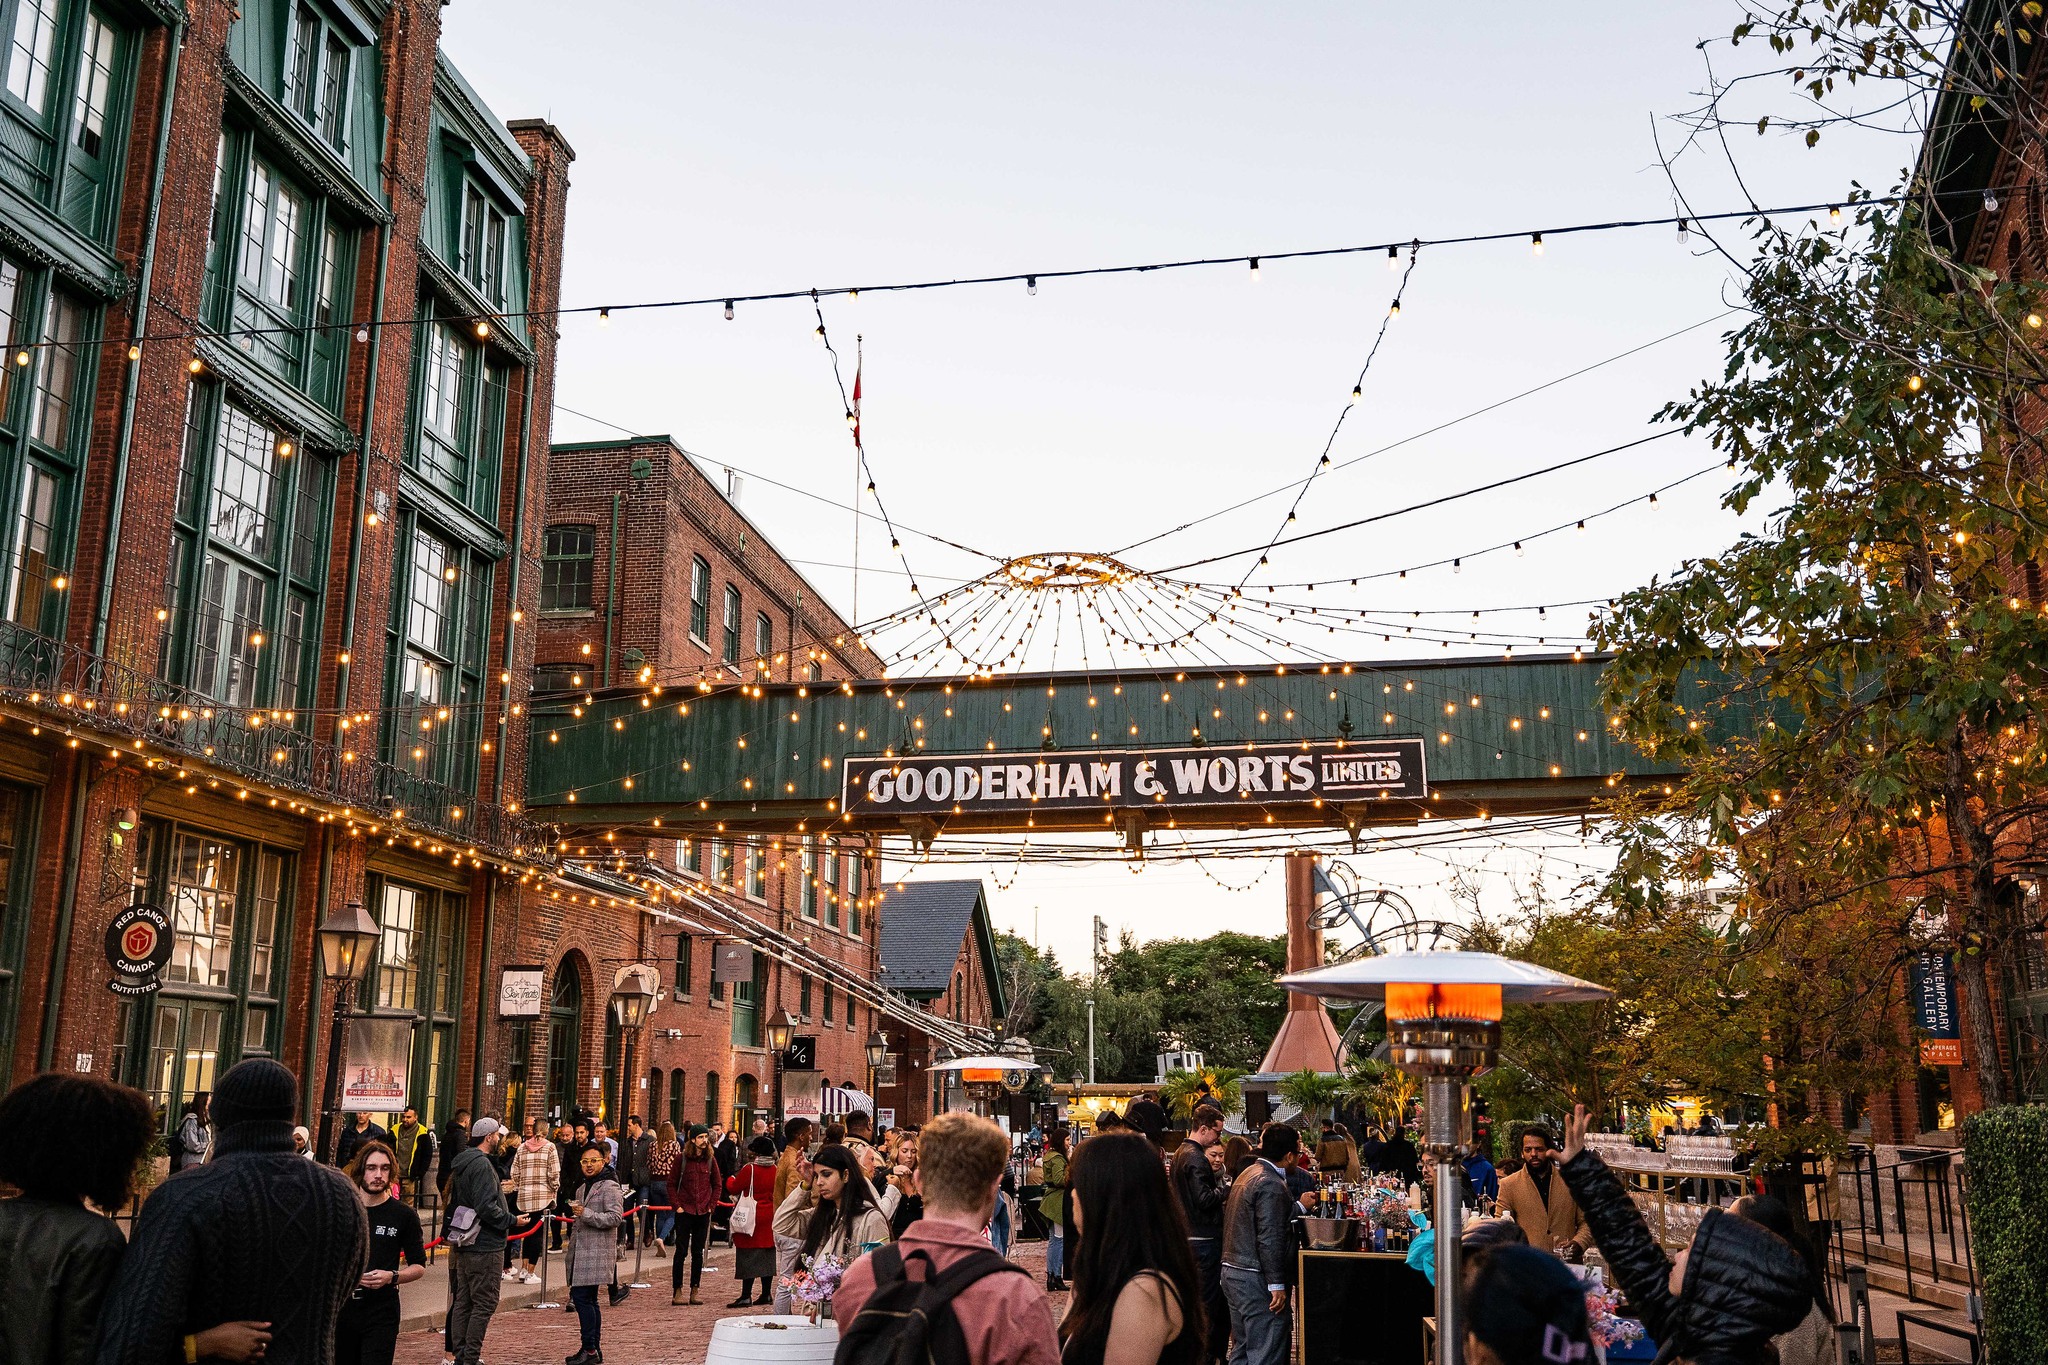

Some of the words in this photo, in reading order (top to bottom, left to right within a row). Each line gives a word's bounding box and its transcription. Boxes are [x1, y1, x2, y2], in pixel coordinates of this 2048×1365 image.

[867, 761, 1122, 803] GOODERHAM
[1133, 759, 1168, 796] &
[1170, 754, 1315, 794] WORTS
[1321, 760, 1402, 783] LIMITED
[115, 911, 135, 930] RED
[136, 908, 167, 930] CANOE
[116, 959, 156, 973] CANADA
[111, 982, 157, 995] OUTFITTER
[504, 986, 519, 998] Skin
[518, 988, 538, 999] Treats
[1934, 953, 1950, 1031] ONTEMPORARY
[1923, 978, 1937, 1031] GALLERY
[359, 1066, 393, 1085] 190
